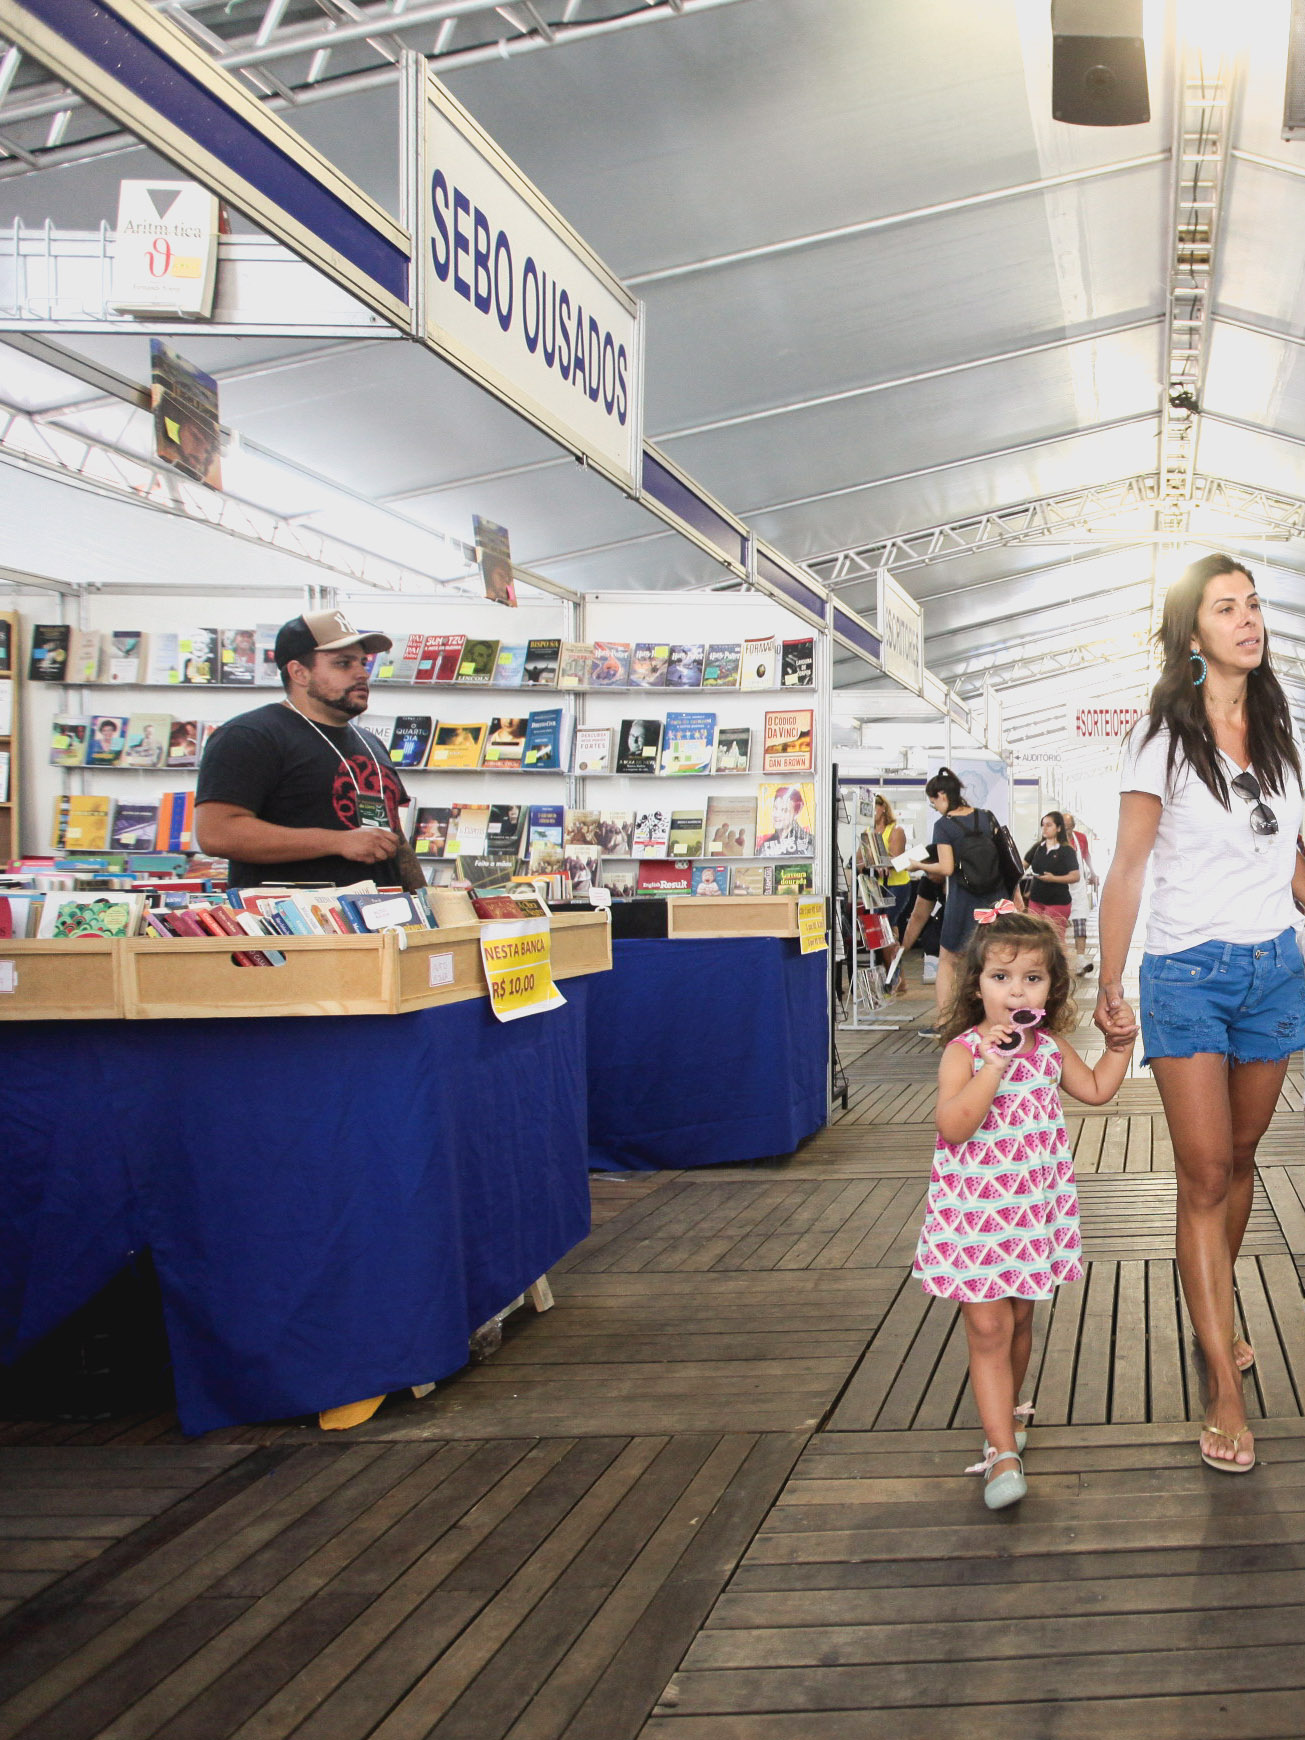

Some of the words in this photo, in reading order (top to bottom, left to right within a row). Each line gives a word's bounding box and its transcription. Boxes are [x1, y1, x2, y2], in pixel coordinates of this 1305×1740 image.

[431, 168, 514, 332] SEBO
[521, 256, 628, 426] OUSADOS
[426, 636, 444, 645] SUN
[448, 636, 465, 644] TZU
[768, 716, 773, 726] O
[1076, 709, 1143, 737] #SORTEIOFEIR
[396, 728, 428, 736] QUARTO
[768, 728, 778, 739] DA
[778, 726, 799, 738] VINCI
[769, 759, 782, 768] DAN
[783, 757, 806, 767] BROWN
[781, 869, 806, 879] Lavoura
[660, 880, 688, 889] Result
[780, 877, 807, 886] dourada
[484, 943, 519, 960] NESTA
[521, 938, 545, 956] BANCA
[492, 978, 506, 1000] R$
[509, 973, 535, 997] 10,00
